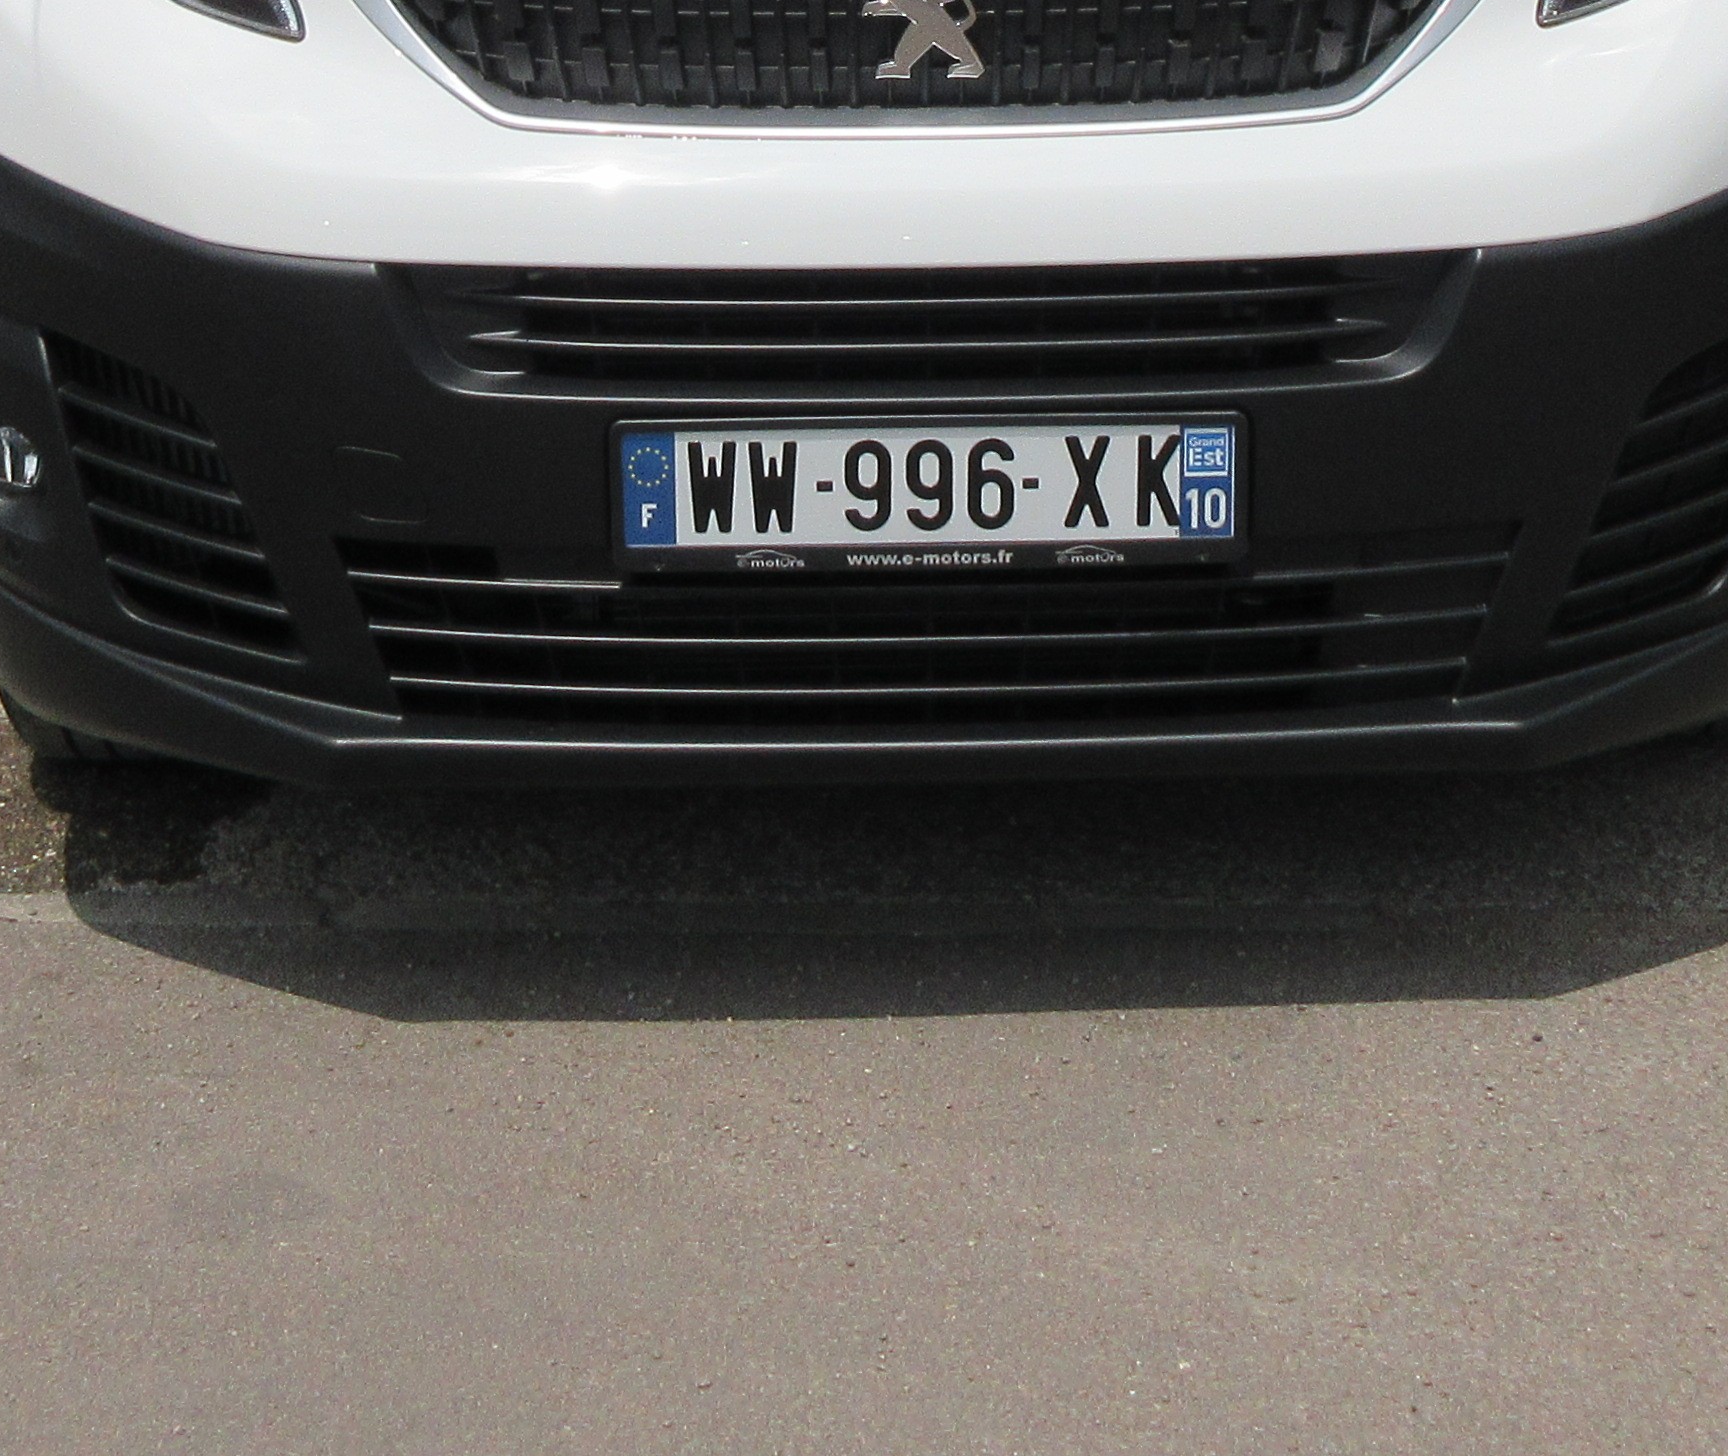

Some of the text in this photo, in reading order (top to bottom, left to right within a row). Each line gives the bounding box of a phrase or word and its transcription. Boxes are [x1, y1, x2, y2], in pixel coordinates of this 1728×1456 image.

[1188, 436, 1225, 447] Grand
[1189, 447, 1224, 466] Est
[641, 503, 658, 529] F
[1185, 488, 1227, 529] 10
[846, 549, 1014, 565] www.e-motors.fr
